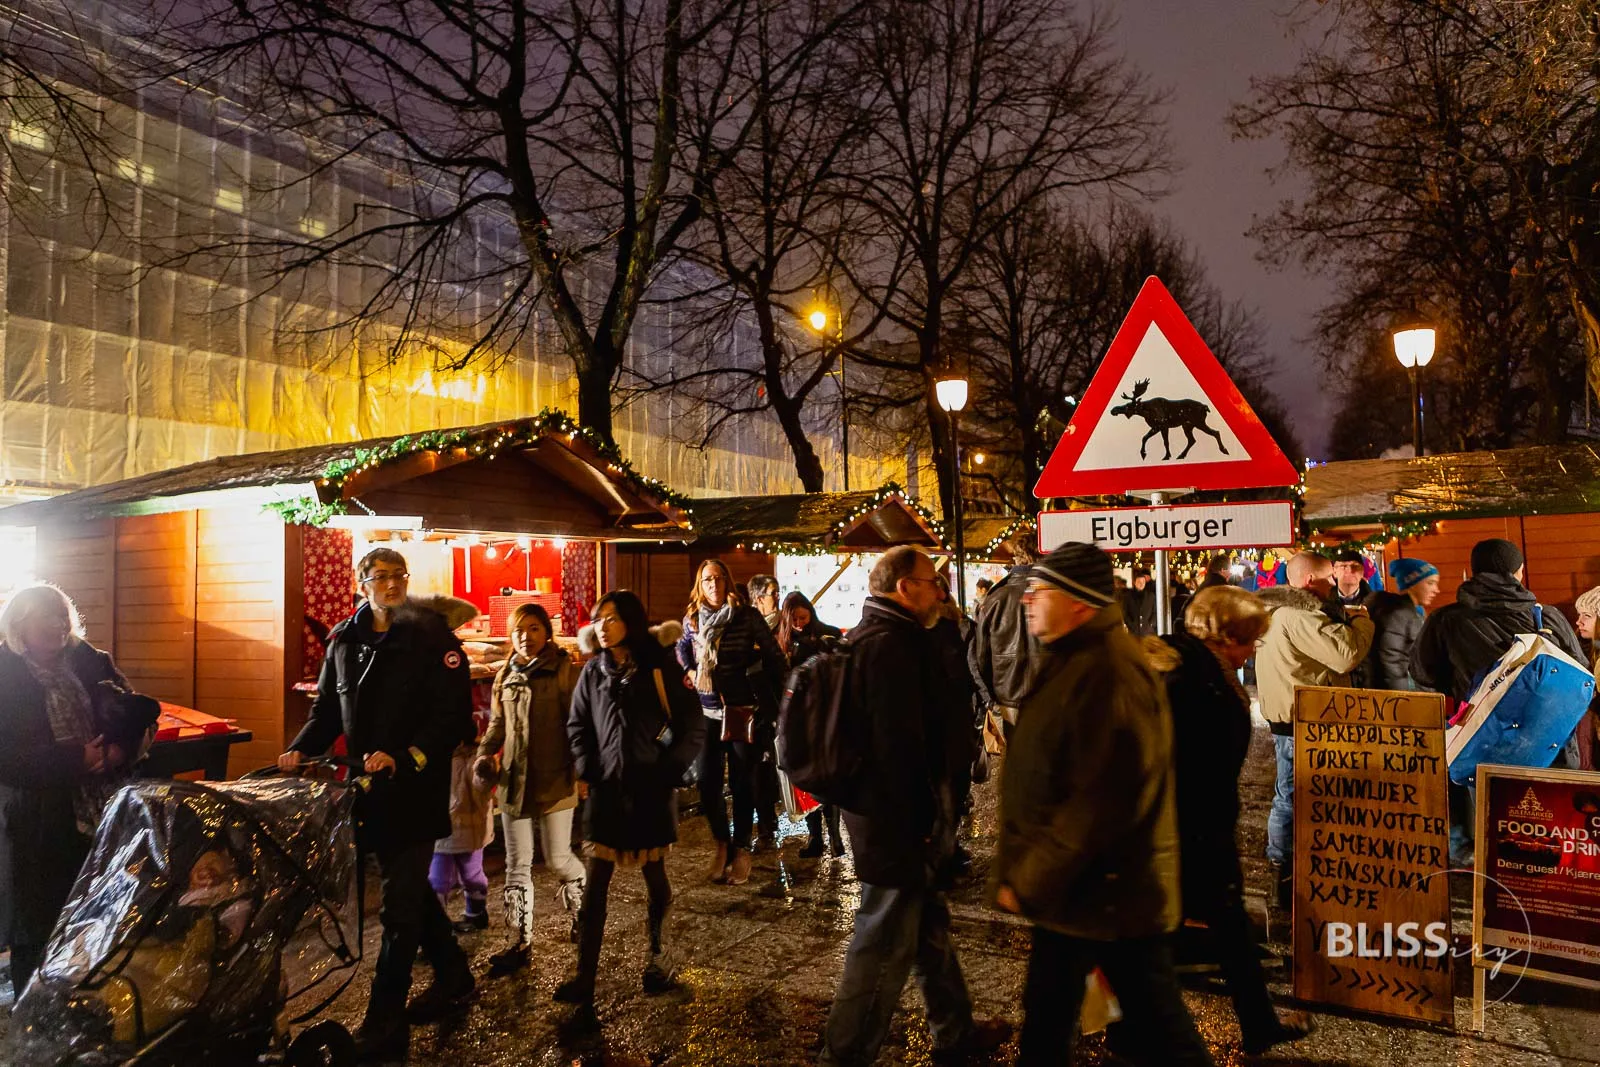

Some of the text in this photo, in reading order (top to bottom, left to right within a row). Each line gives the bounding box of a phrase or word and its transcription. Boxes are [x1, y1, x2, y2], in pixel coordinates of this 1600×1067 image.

[1091, 515, 1233, 546] Elgburger
[1320, 691, 1410, 721] ÅPENT
[1305, 723, 1428, 748] SPEKEPØLSER
[1306, 748, 1440, 774] TØRKET KJØTT
[1310, 801, 1446, 836] SKINNVOTTER
[1497, 820, 1589, 842] FOOD AND
[1310, 829, 1443, 868] SAMEKNIVER
[1309, 854, 1432, 893] REINSKINN
[1497, 858, 1524, 871] Dear
[1526, 864, 1558, 875] guest
[1566, 867, 1600, 880] Kjære
[1309, 880, 1379, 910] KAFFE
